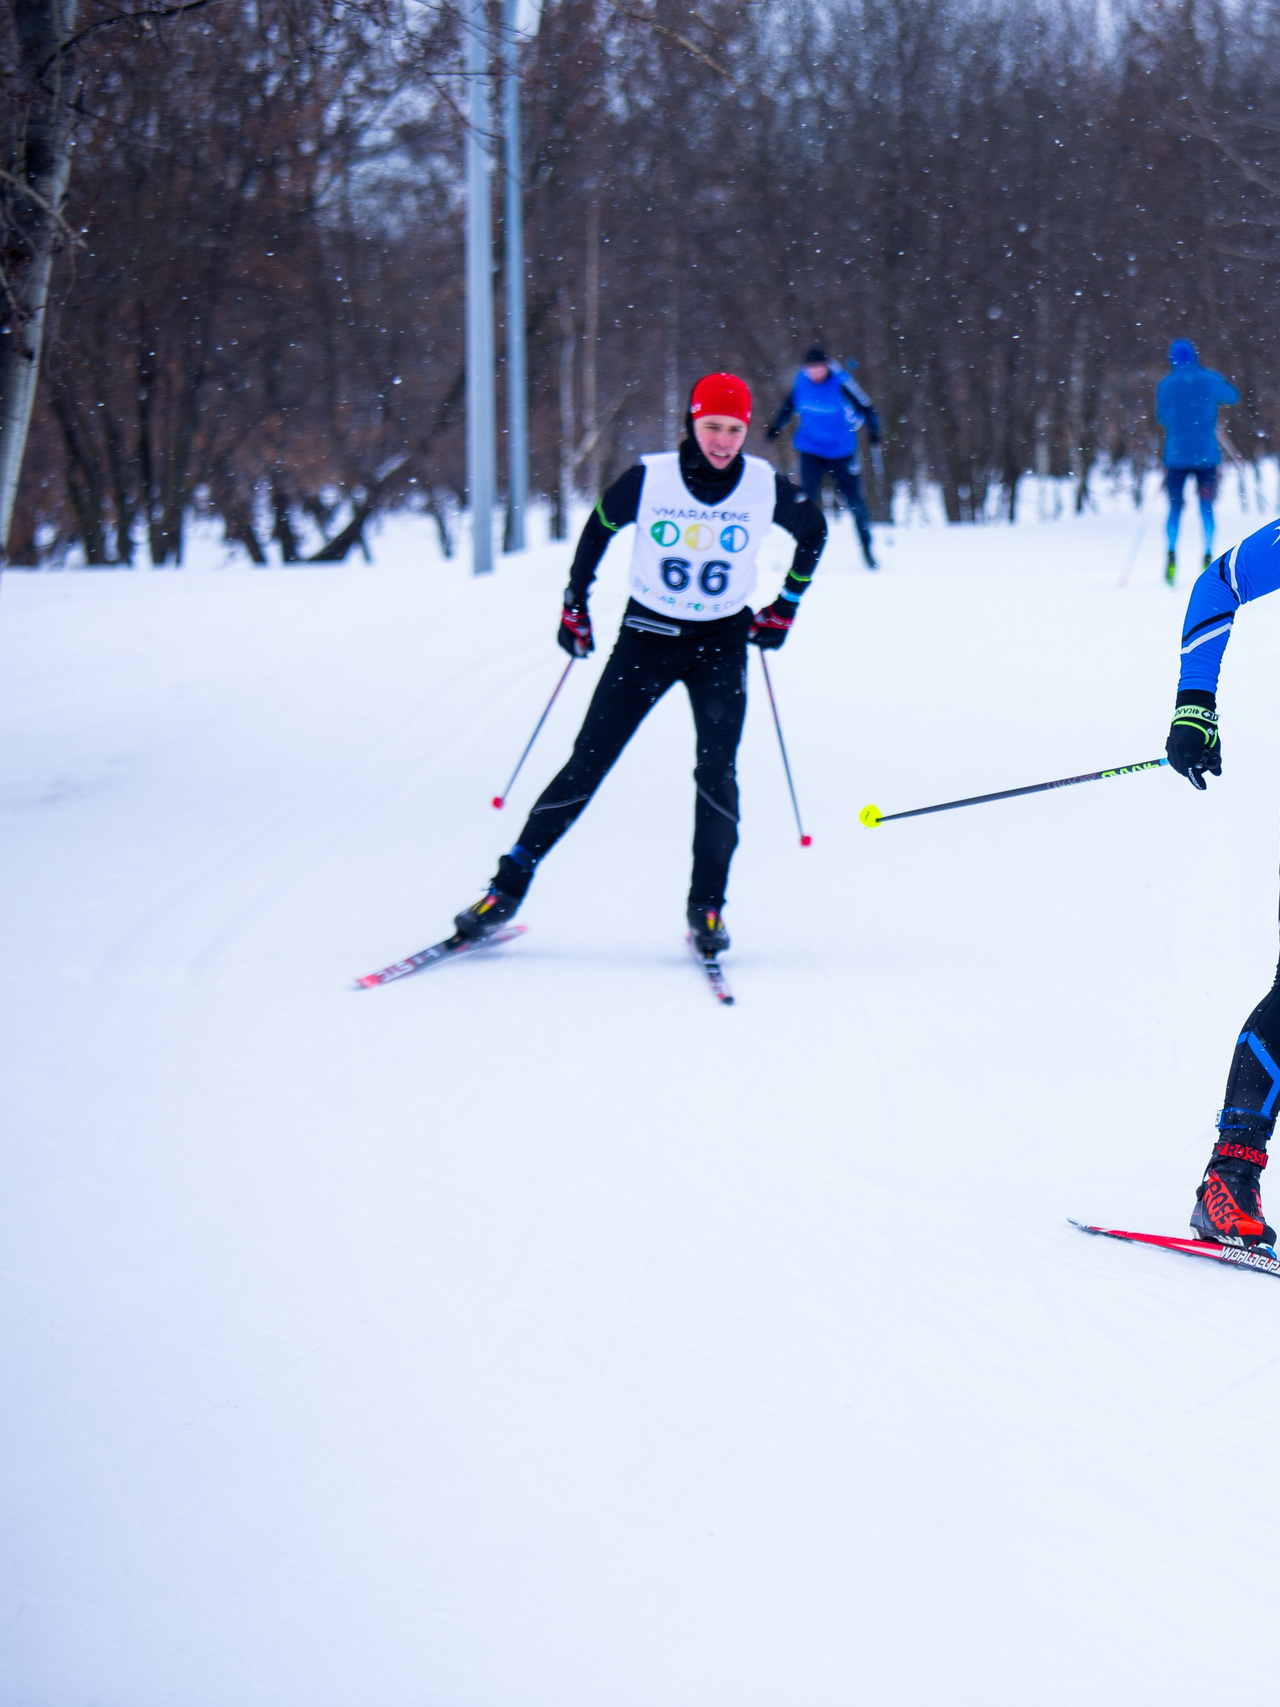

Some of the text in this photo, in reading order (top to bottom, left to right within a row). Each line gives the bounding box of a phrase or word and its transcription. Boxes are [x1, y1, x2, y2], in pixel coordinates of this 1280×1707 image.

[652, 507, 751, 523] VMARAFONE
[659, 556, 732, 598] 66
[1220, 1245, 1280, 1272] WORLDCUP
